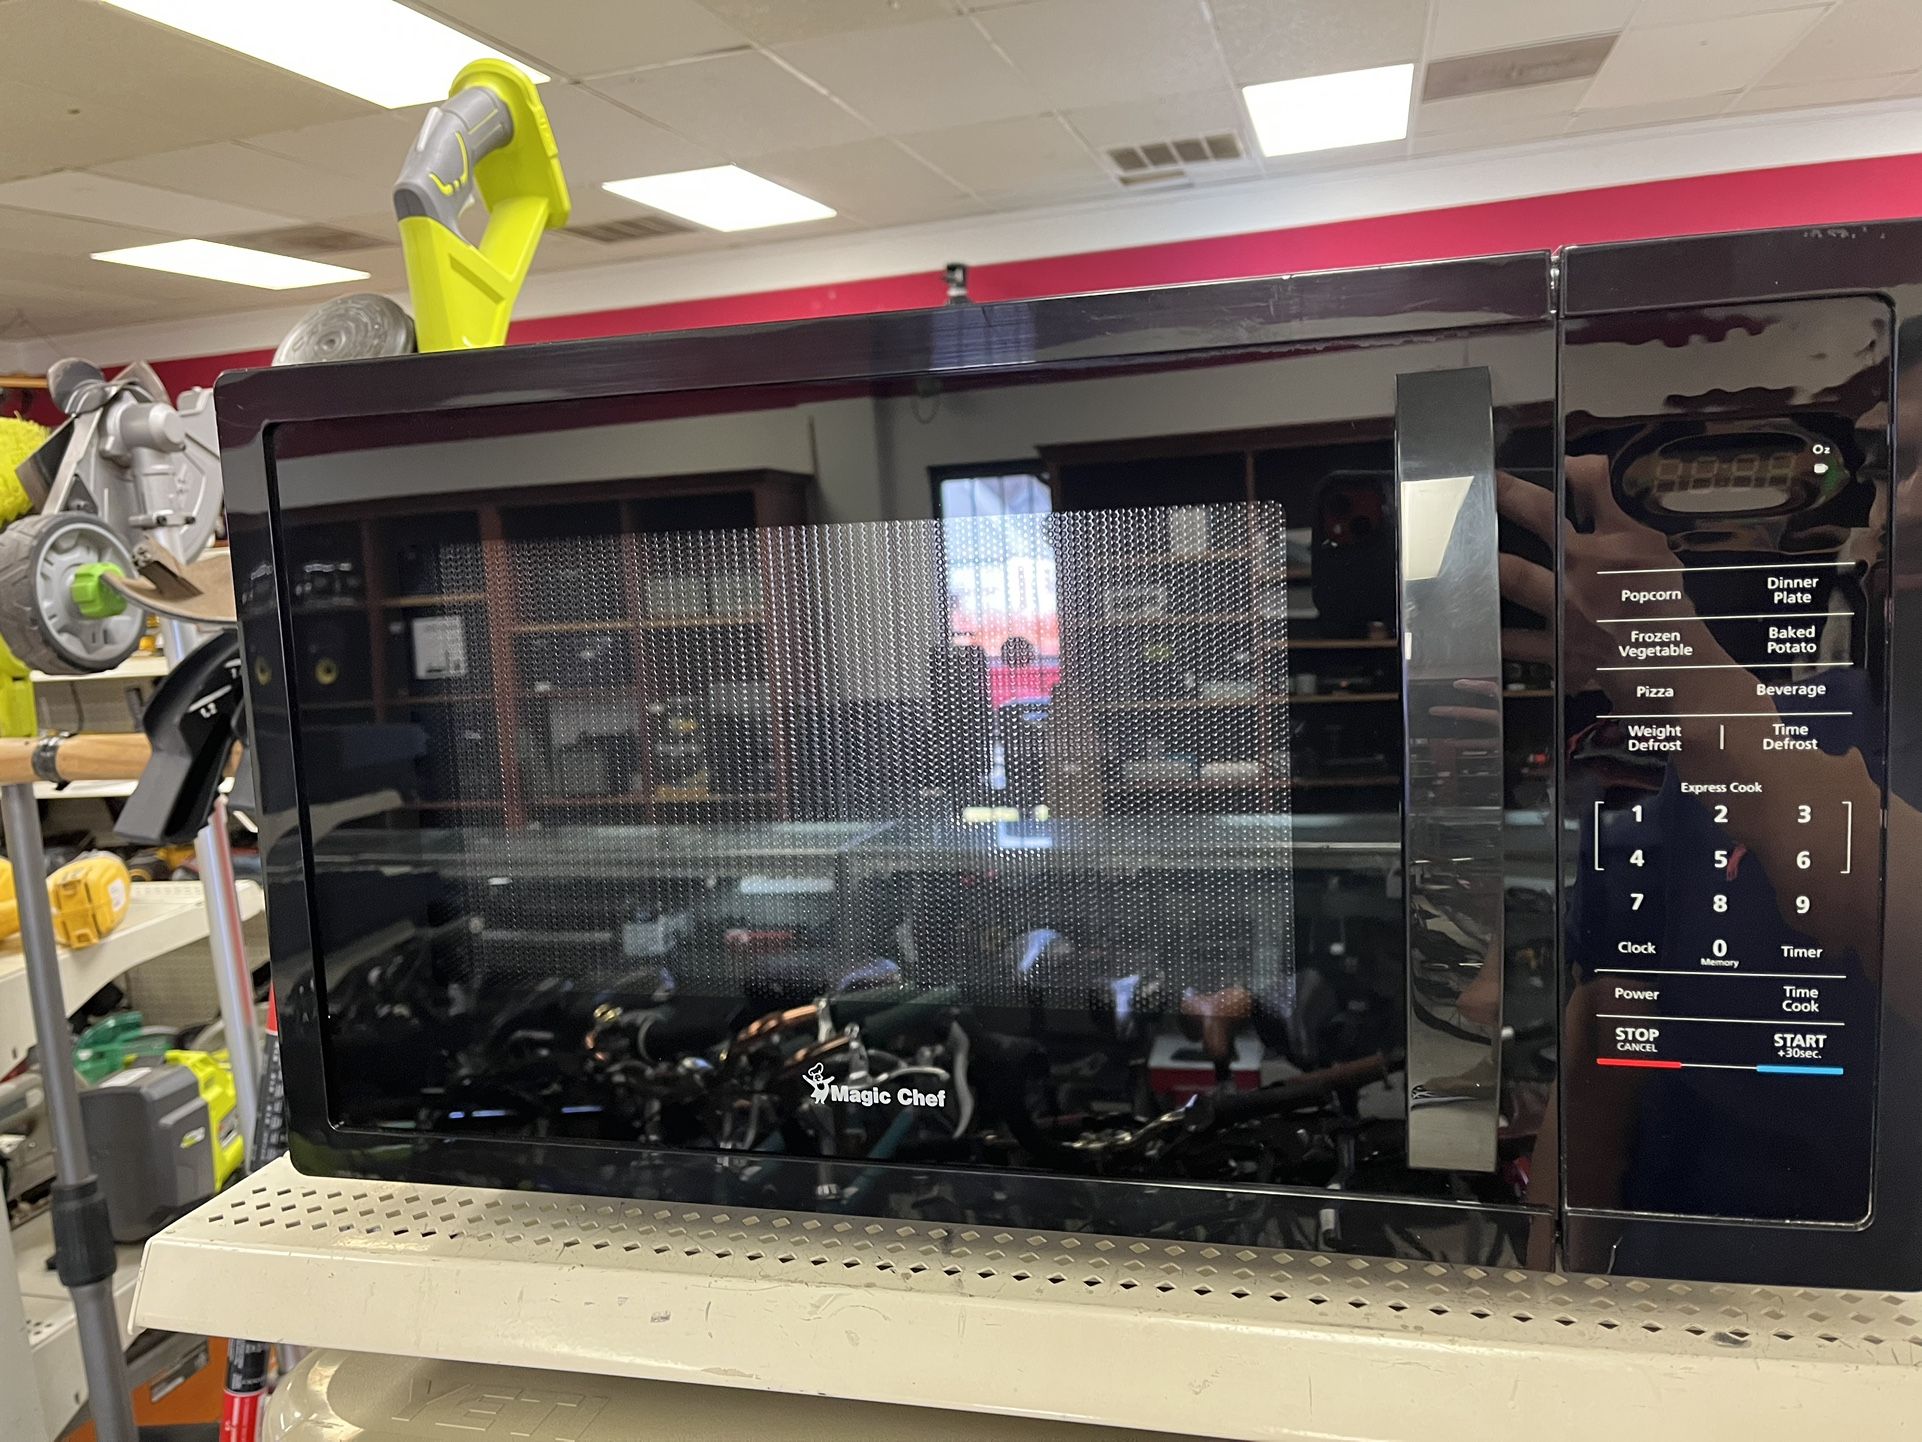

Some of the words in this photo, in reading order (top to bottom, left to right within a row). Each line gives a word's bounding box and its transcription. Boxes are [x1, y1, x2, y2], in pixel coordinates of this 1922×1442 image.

[1812, 444, 1831, 455] Oz
[1766, 576, 1820, 590] Dinner
[1621, 589, 1682, 604] Popcorn
[1773, 590, 1813, 605] Plate
[1630, 630, 1682, 643] Frozen
[1767, 624, 1816, 640] Baked
[1618, 643, 1694, 660] Vegetable
[1766, 640, 1818, 655] Potato
[1636, 685, 1674, 698] Pizza
[1756, 683, 1827, 698] Beverage
[1627, 724, 1682, 739] Weight
[1772, 723, 1809, 737] Time
[1627, 738, 1683, 752] Defrost
[1762, 737, 1819, 751] Defrost
[1680, 782, 1727, 795] Express
[1729, 781, 1763, 793] Cook
[1631, 804, 1642, 823] 1
[1713, 804, 1729, 823] 2
[1797, 804, 1812, 824] 3
[1629, 849, 1645, 867] 4
[1714, 850, 1728, 869] 5
[1796, 850, 1811, 869] 6
[1630, 893, 1644, 911] 7
[1712, 894, 1728, 913] 8
[1795, 895, 1810, 914] 9
[1617, 941, 1657, 954] Clock
[1711, 938, 1728, 957] 0
[1780, 945, 1823, 958] Timer
[1699, 957, 1740, 969] Memory
[1614, 987, 1660, 1000] Power
[1782, 985, 1819, 999] Time
[1781, 999, 1820, 1013] Cook
[1614, 1027, 1660, 1042] STOP
[1773, 1033, 1828, 1048] START
[1616, 1041, 1659, 1053] CANCEL
[1776, 1048, 1823, 1059] +30sec.
[830, 1084, 892, 1108] Magic
[896, 1087, 947, 1108] Chef
